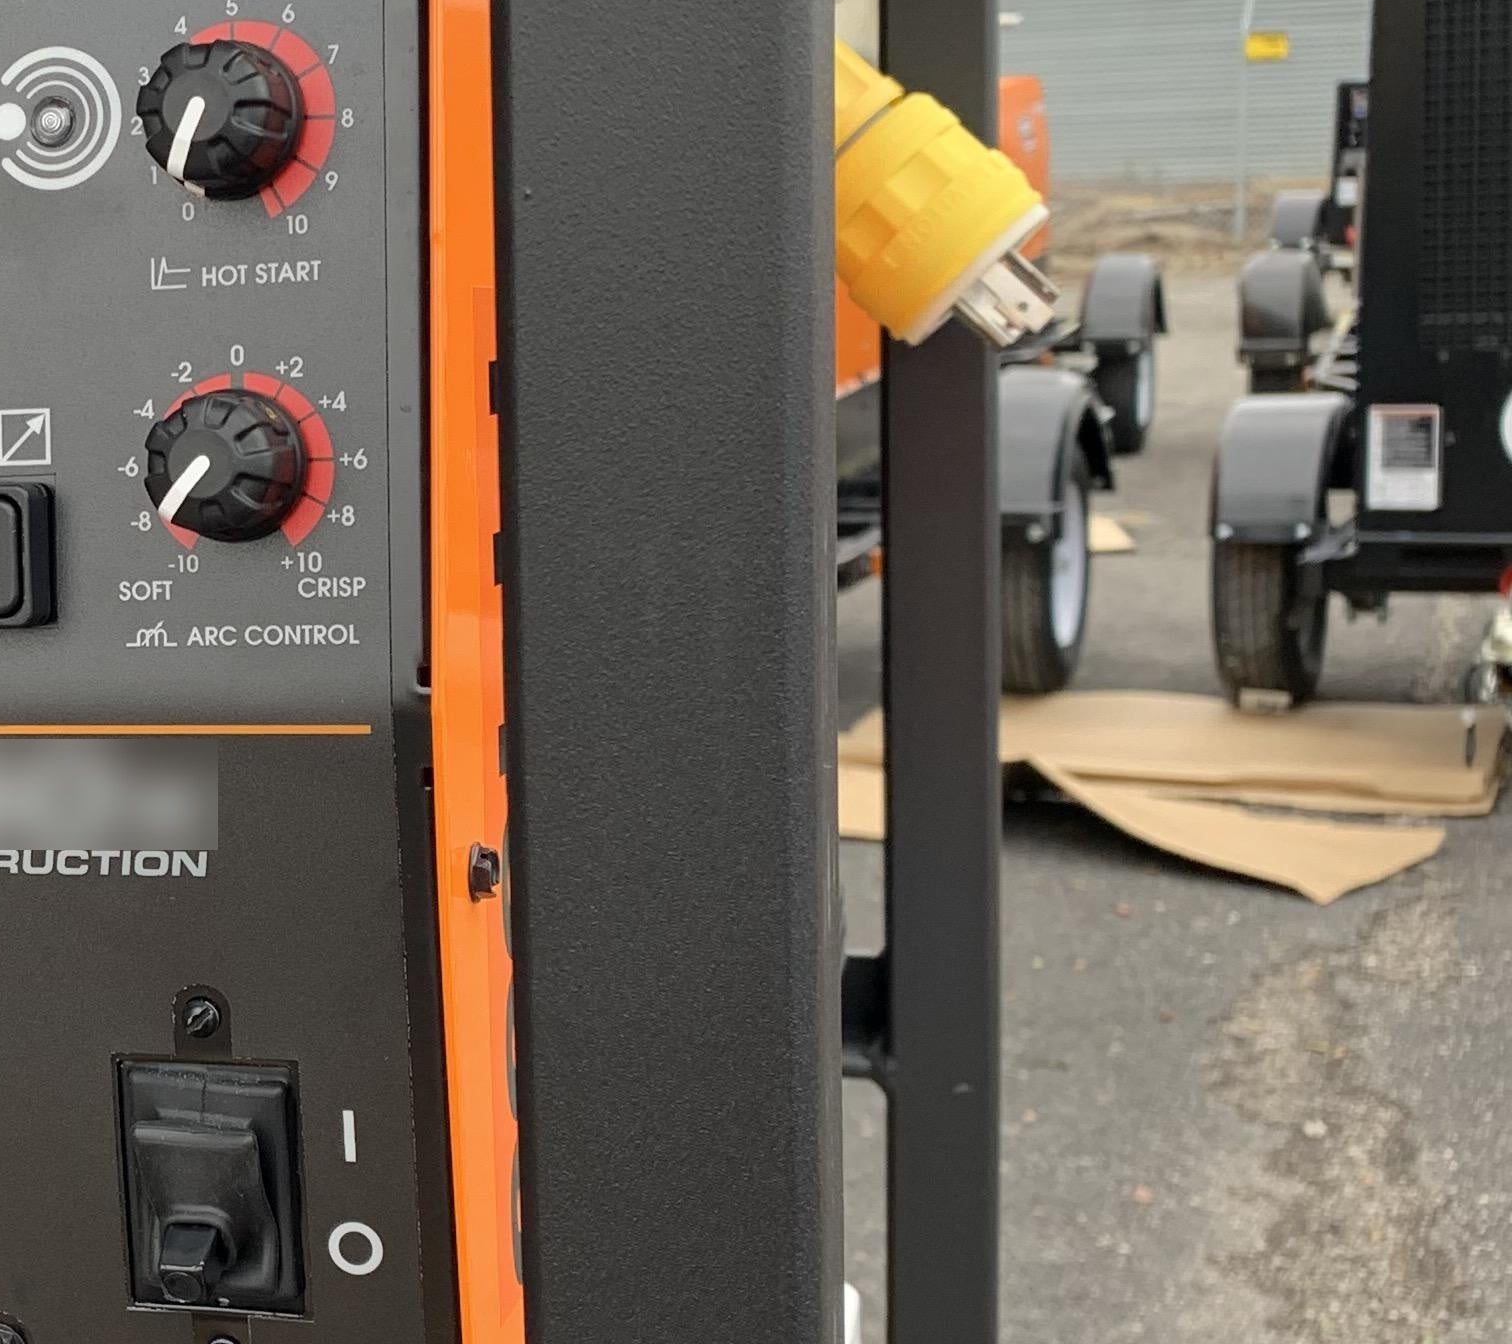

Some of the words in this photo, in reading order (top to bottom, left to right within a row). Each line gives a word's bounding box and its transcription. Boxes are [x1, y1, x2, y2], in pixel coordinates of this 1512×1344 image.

[282, 3, 295, 23] 6
[174, 16, 187, 35] 4
[327, 45, 339, 64] 7
[138, 67, 150, 85] 3
[131, 117, 143, 135] 2
[341, 108, 354, 128] 8
[150, 166, 158, 184] 1
[325, 171, 338, 191] 9
[287, 215, 308, 235] 10
[201, 264, 247, 287] HOT
[255, 260, 321, 284] START
[230, 345, 244, 366] 0
[171, 362, 193, 383] -2
[275, 357, 304, 378] +2
[133, 400, 155, 420] -4
[318, 391, 347, 412] +4
[117, 457, 139, 478] -6
[339, 448, 368, 470] +6
[130, 512, 152, 532] -8
[327, 506, 355, 528] +8
[168, 554, 199, 573] -10
[280, 552, 322, 573] +10
[118, 580, 173, 601] SOFT
[298, 577, 366, 598] CRISP
[187, 625, 237, 646] ARC
[244, 624, 360, 646] CONTROL
